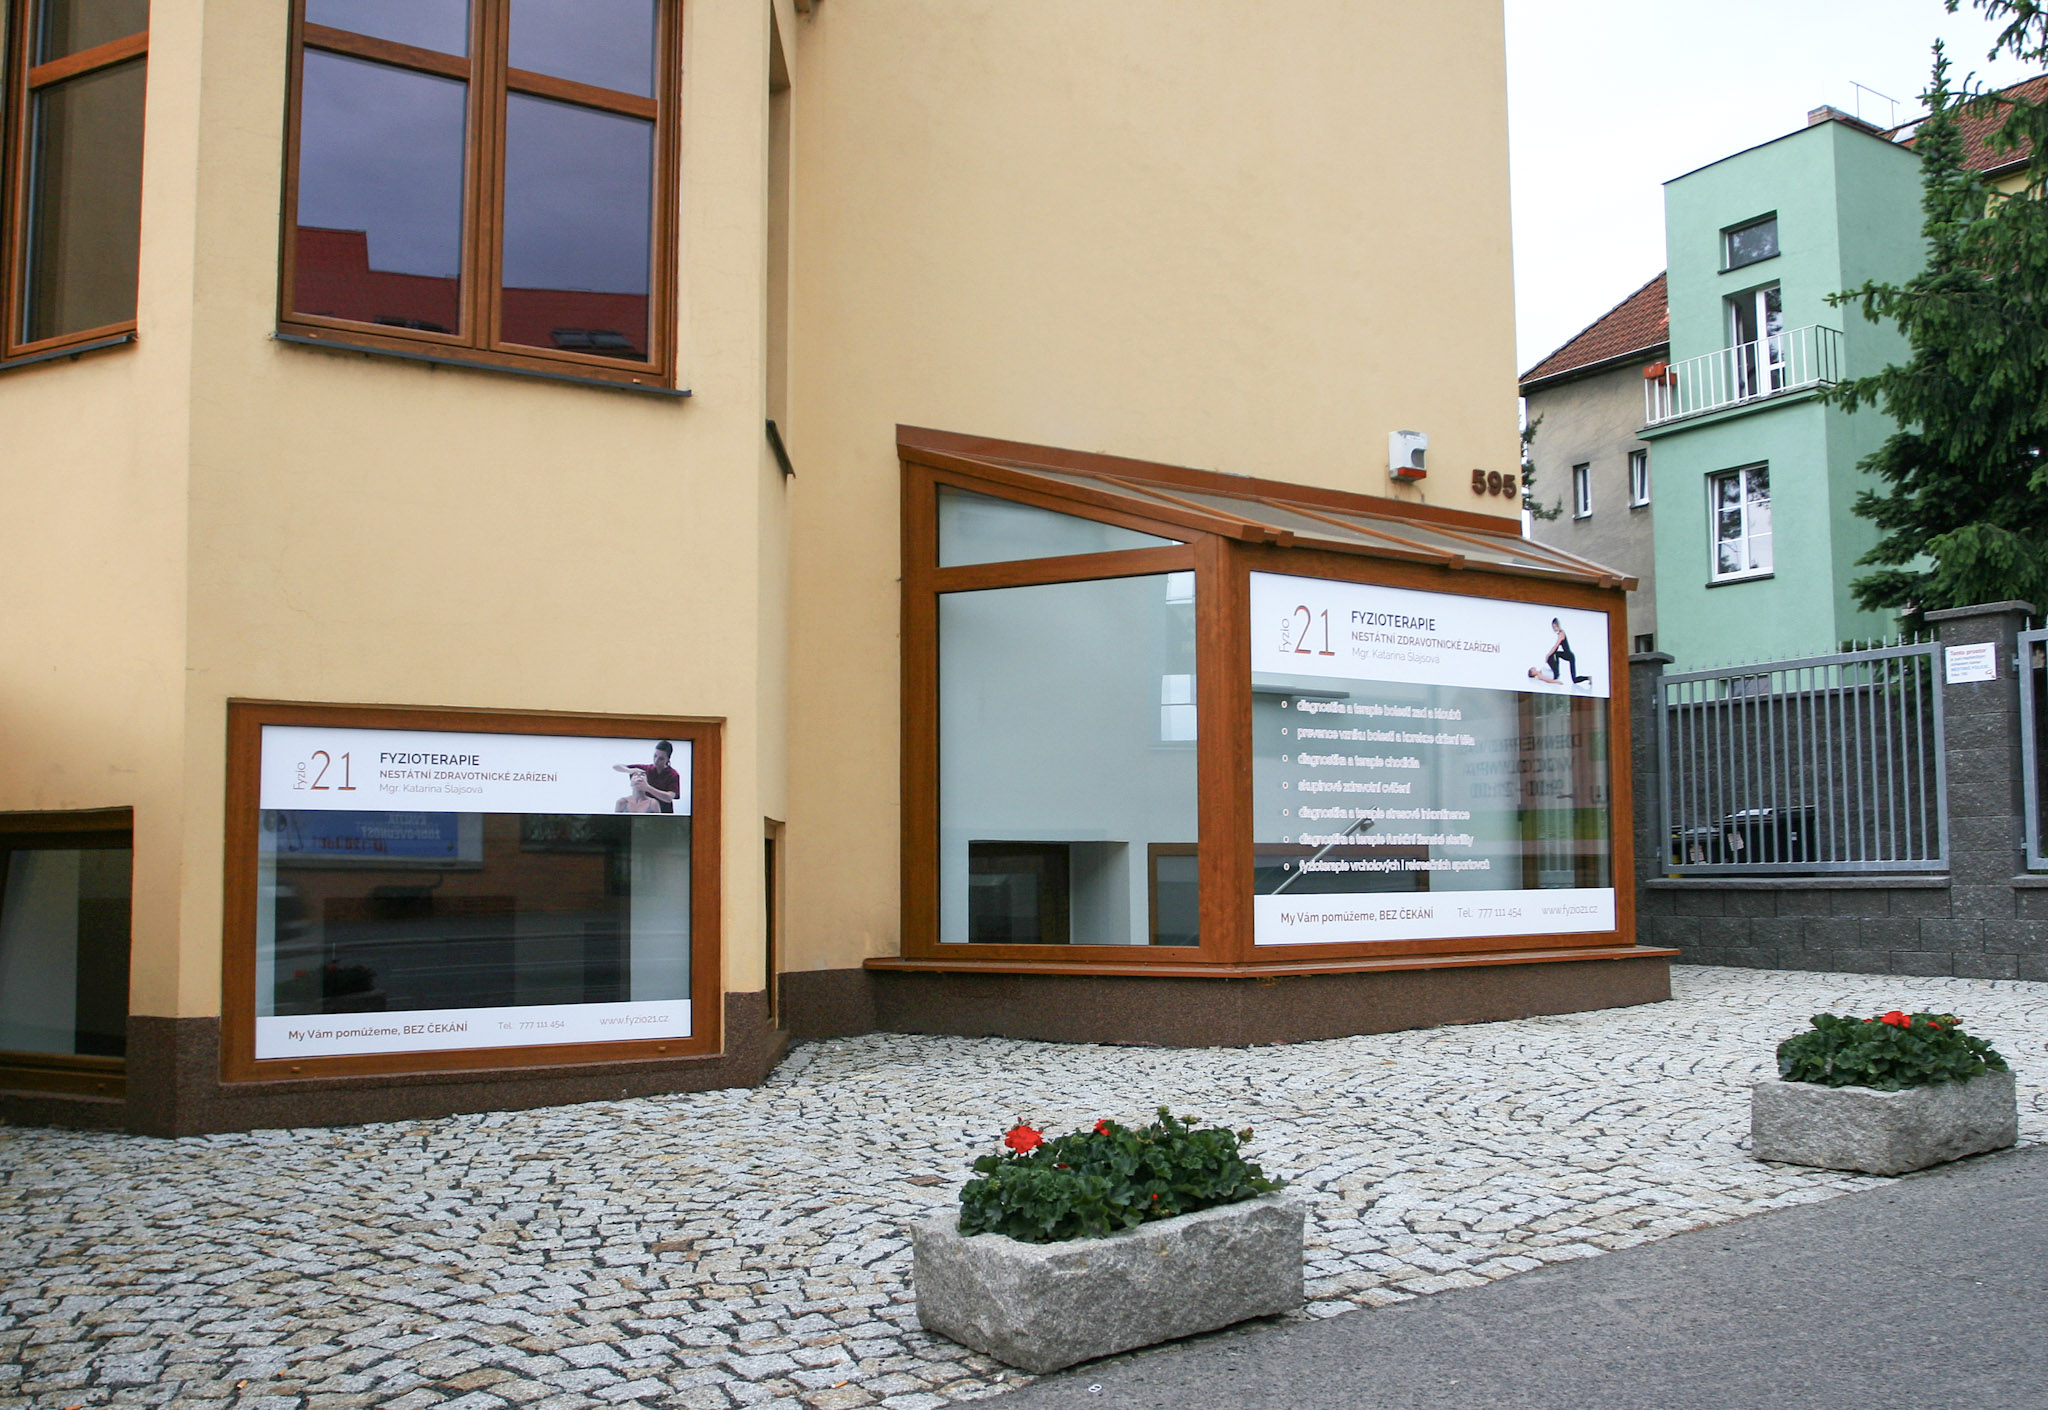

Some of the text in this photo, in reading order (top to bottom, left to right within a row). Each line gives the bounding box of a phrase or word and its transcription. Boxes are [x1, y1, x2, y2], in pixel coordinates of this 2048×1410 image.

[1472, 469, 1516, 499] 595
[1351, 610, 1435, 631] FYZIOTERAPIE
[1279, 619, 1292, 652] Fyzio
[1294, 605, 1335, 656] 21
[1352, 631, 1500, 653] NESTÁTNÍ ZDRAVOTNICKÉ ZAŘÍZENÍ
[1352, 647, 1369, 660] Mgr.
[380, 752, 480, 765] FYZIOTERAPIE
[293, 762, 307, 789] Fyzio
[310, 750, 356, 790] 21
[380, 769, 557, 782] NESTÁTNÍ ZDRAVOTNICKÉ ZAŘÍZENÍ
[379, 784, 399, 794] Mgr.
[1299, 860, 1349, 874] fyzioterapie
[1281, 913, 1295, 925] My
[1297, 912, 1319, 922] Vám
[1380, 910, 1397, 920] BEZ
[1400, 906, 1433, 919] ČEKÁNÍ
[1478, 908, 1493, 919] 777
[1495, 908, 1505, 917] 111
[1508, 908, 1521, 917] 454
[1541, 904, 1598, 916] www.fyzio21.cz
[600, 1015, 669, 1025] www.fyzio21.cz
[288, 1031, 304, 1041] My
[307, 1029, 333, 1038] Vám
[403, 1025, 424, 1034] BEZ
[427, 1021, 467, 1033] ČEKÁNÍ
